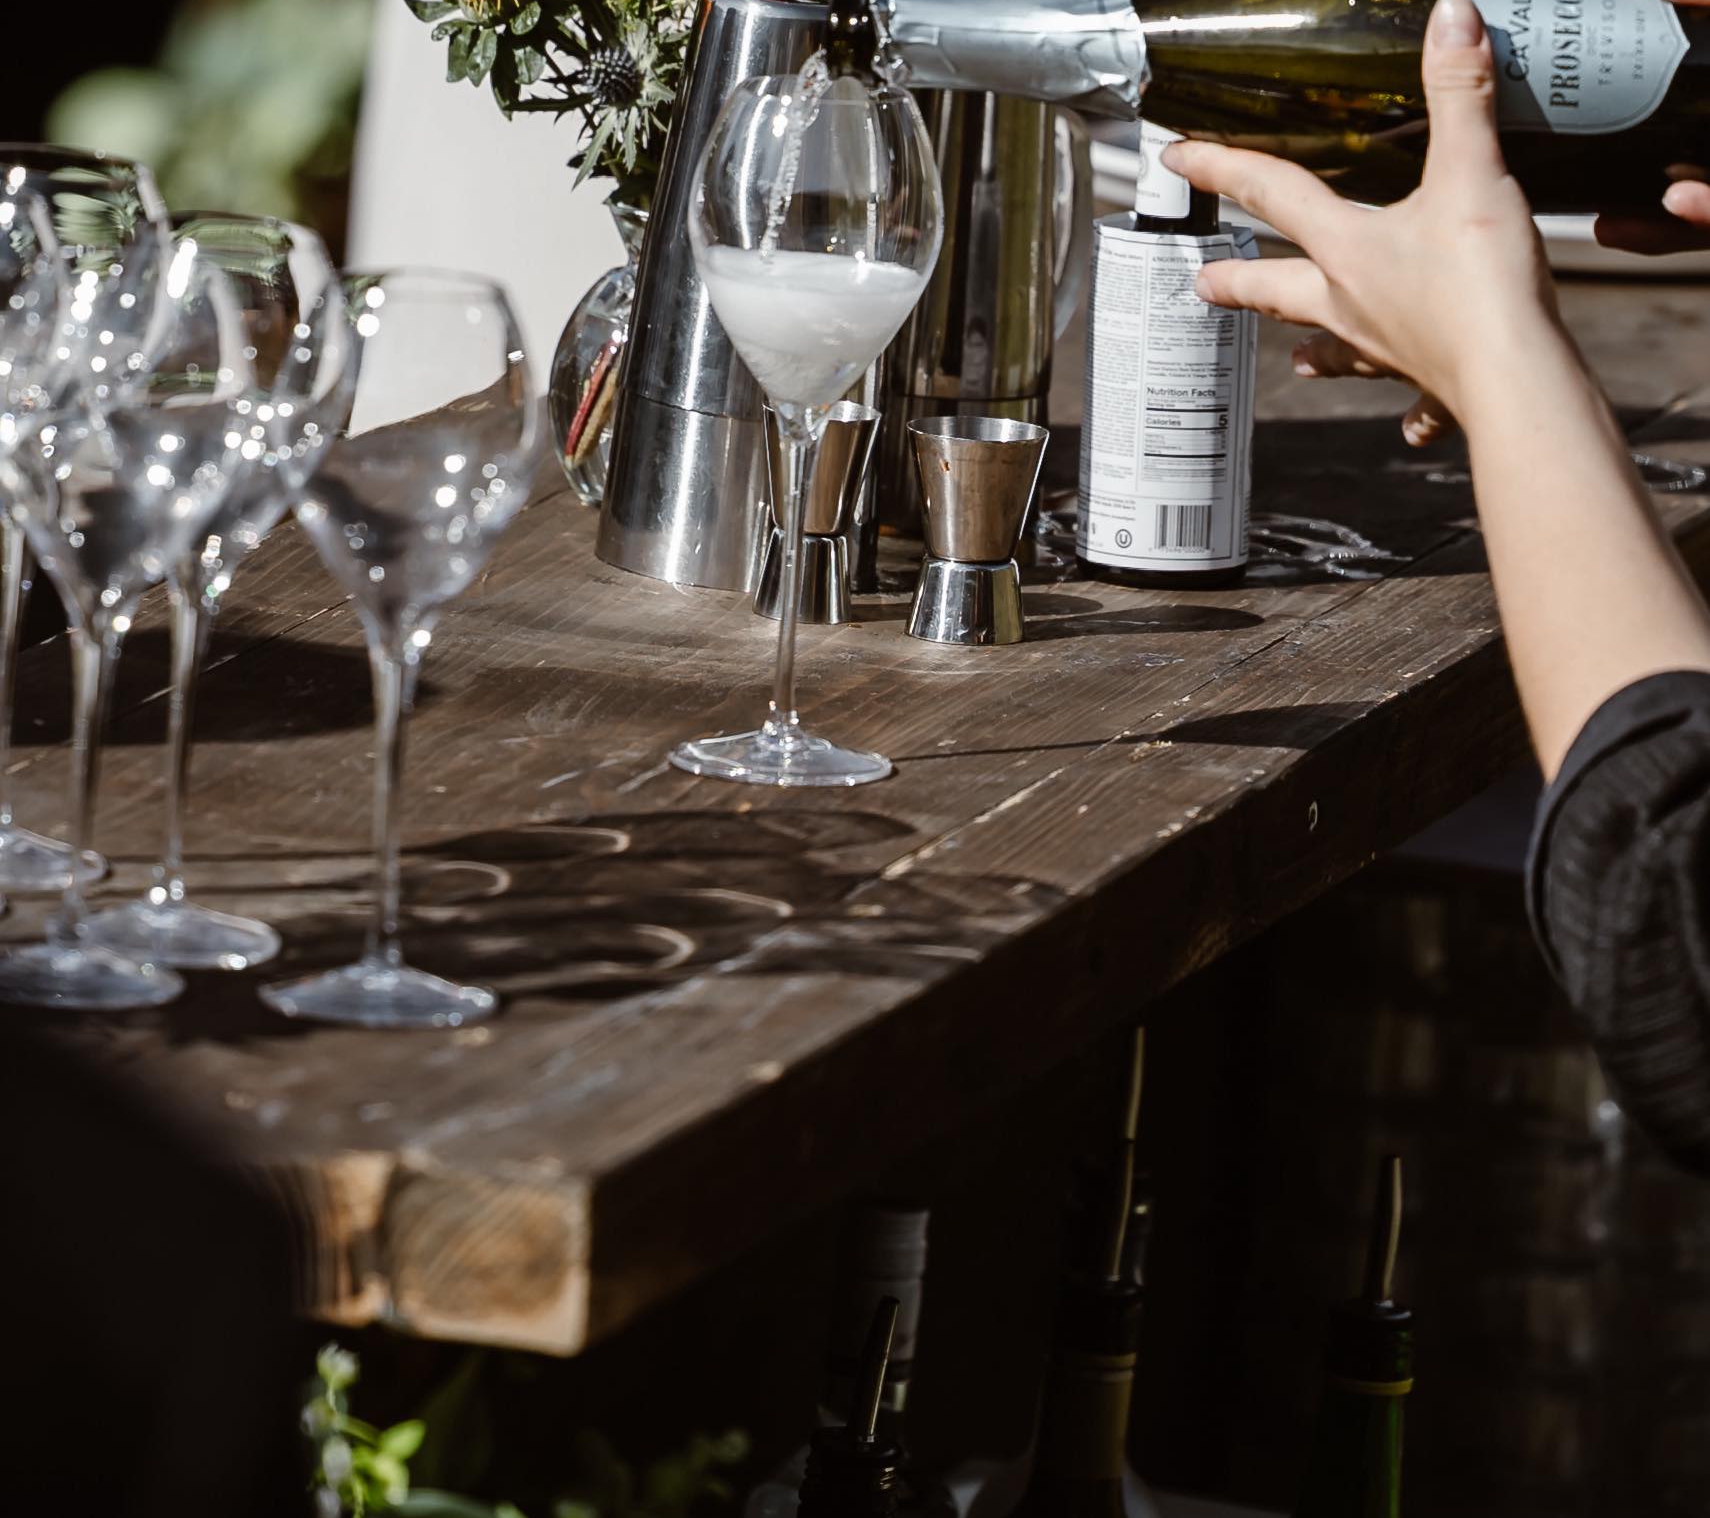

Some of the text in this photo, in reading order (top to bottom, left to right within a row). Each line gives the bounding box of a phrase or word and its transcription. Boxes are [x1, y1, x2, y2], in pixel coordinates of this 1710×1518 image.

[1147, 387, 1216, 397] Nutrition Facts
[1145, 414, 1228, 427] Calories 5
